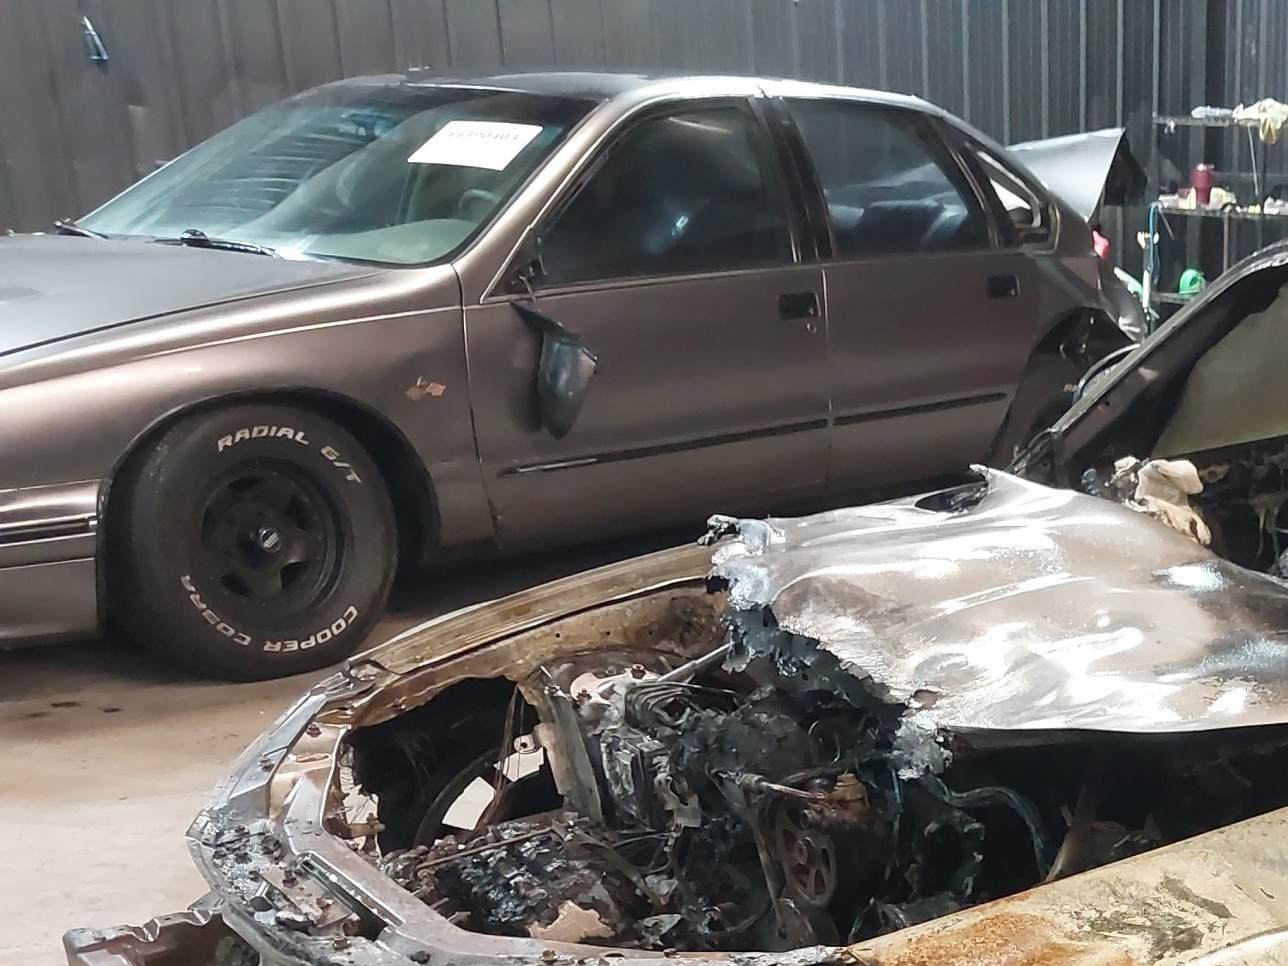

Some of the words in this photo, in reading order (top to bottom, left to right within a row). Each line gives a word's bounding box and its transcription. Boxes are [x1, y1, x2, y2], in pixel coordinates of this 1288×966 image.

[217, 425, 310, 453] RADIAL
[320, 445, 362, 484] G/T
[180, 574, 252, 646] COBRA
[262, 605, 359, 652] COOPER
